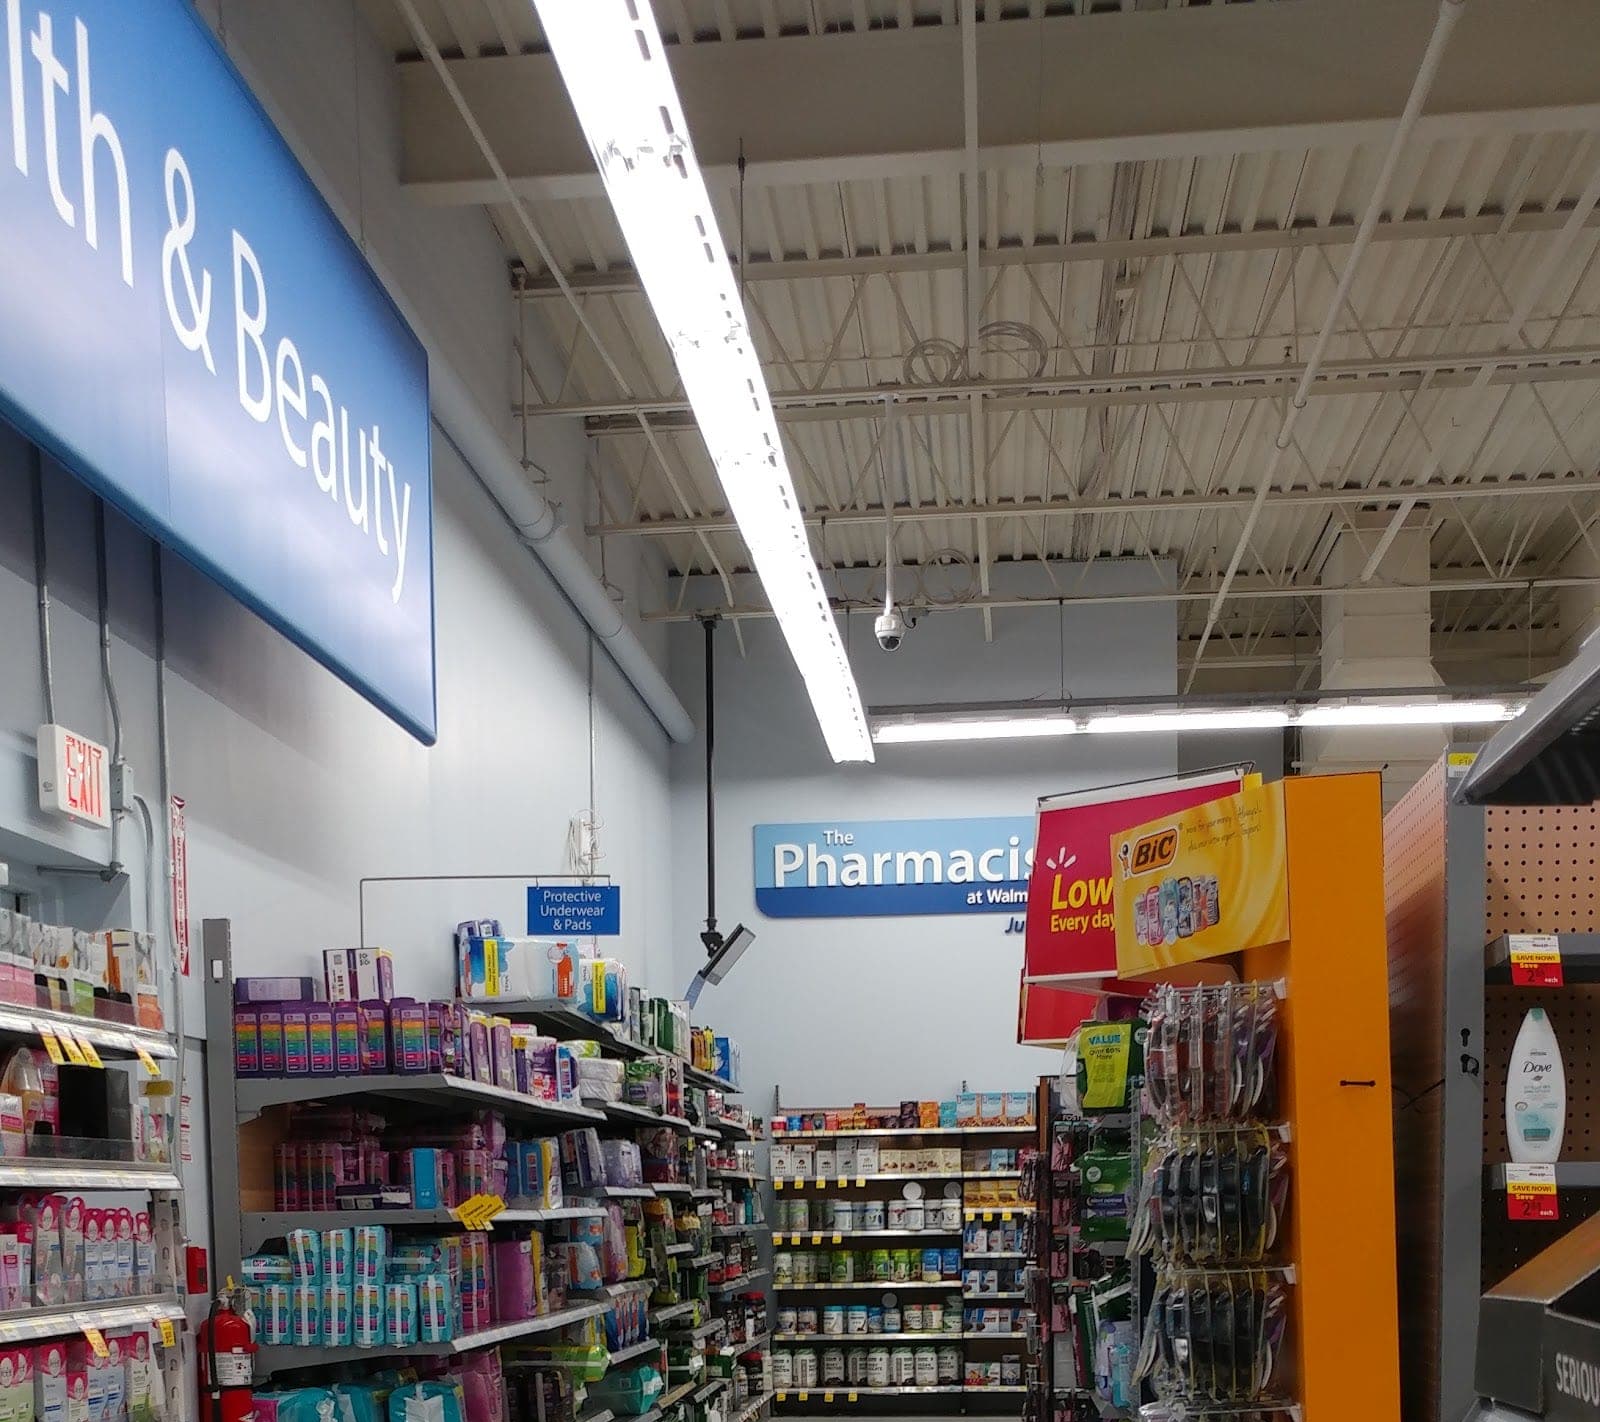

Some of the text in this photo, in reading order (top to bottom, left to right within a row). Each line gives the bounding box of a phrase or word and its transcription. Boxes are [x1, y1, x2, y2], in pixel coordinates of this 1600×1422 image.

[161, 147, 217, 376] &
[231, 228, 412, 604] Beauty
[65, 734, 103, 818] EXIT
[823, 830, 854, 846] The
[543, 890, 602, 903] Protective
[966, 891, 983, 905] at
[1051, 873, 1114, 911] Low
[540, 904, 606, 917] Underwear
[553, 918, 592, 931] & Pads
[1051, 914, 1089, 934] Every
[1088, 1034, 1121, 1046] VALUE
[1523, 1061, 1552, 1073] Dove
[1555, 1352, 1600, 1407] SERIOU
